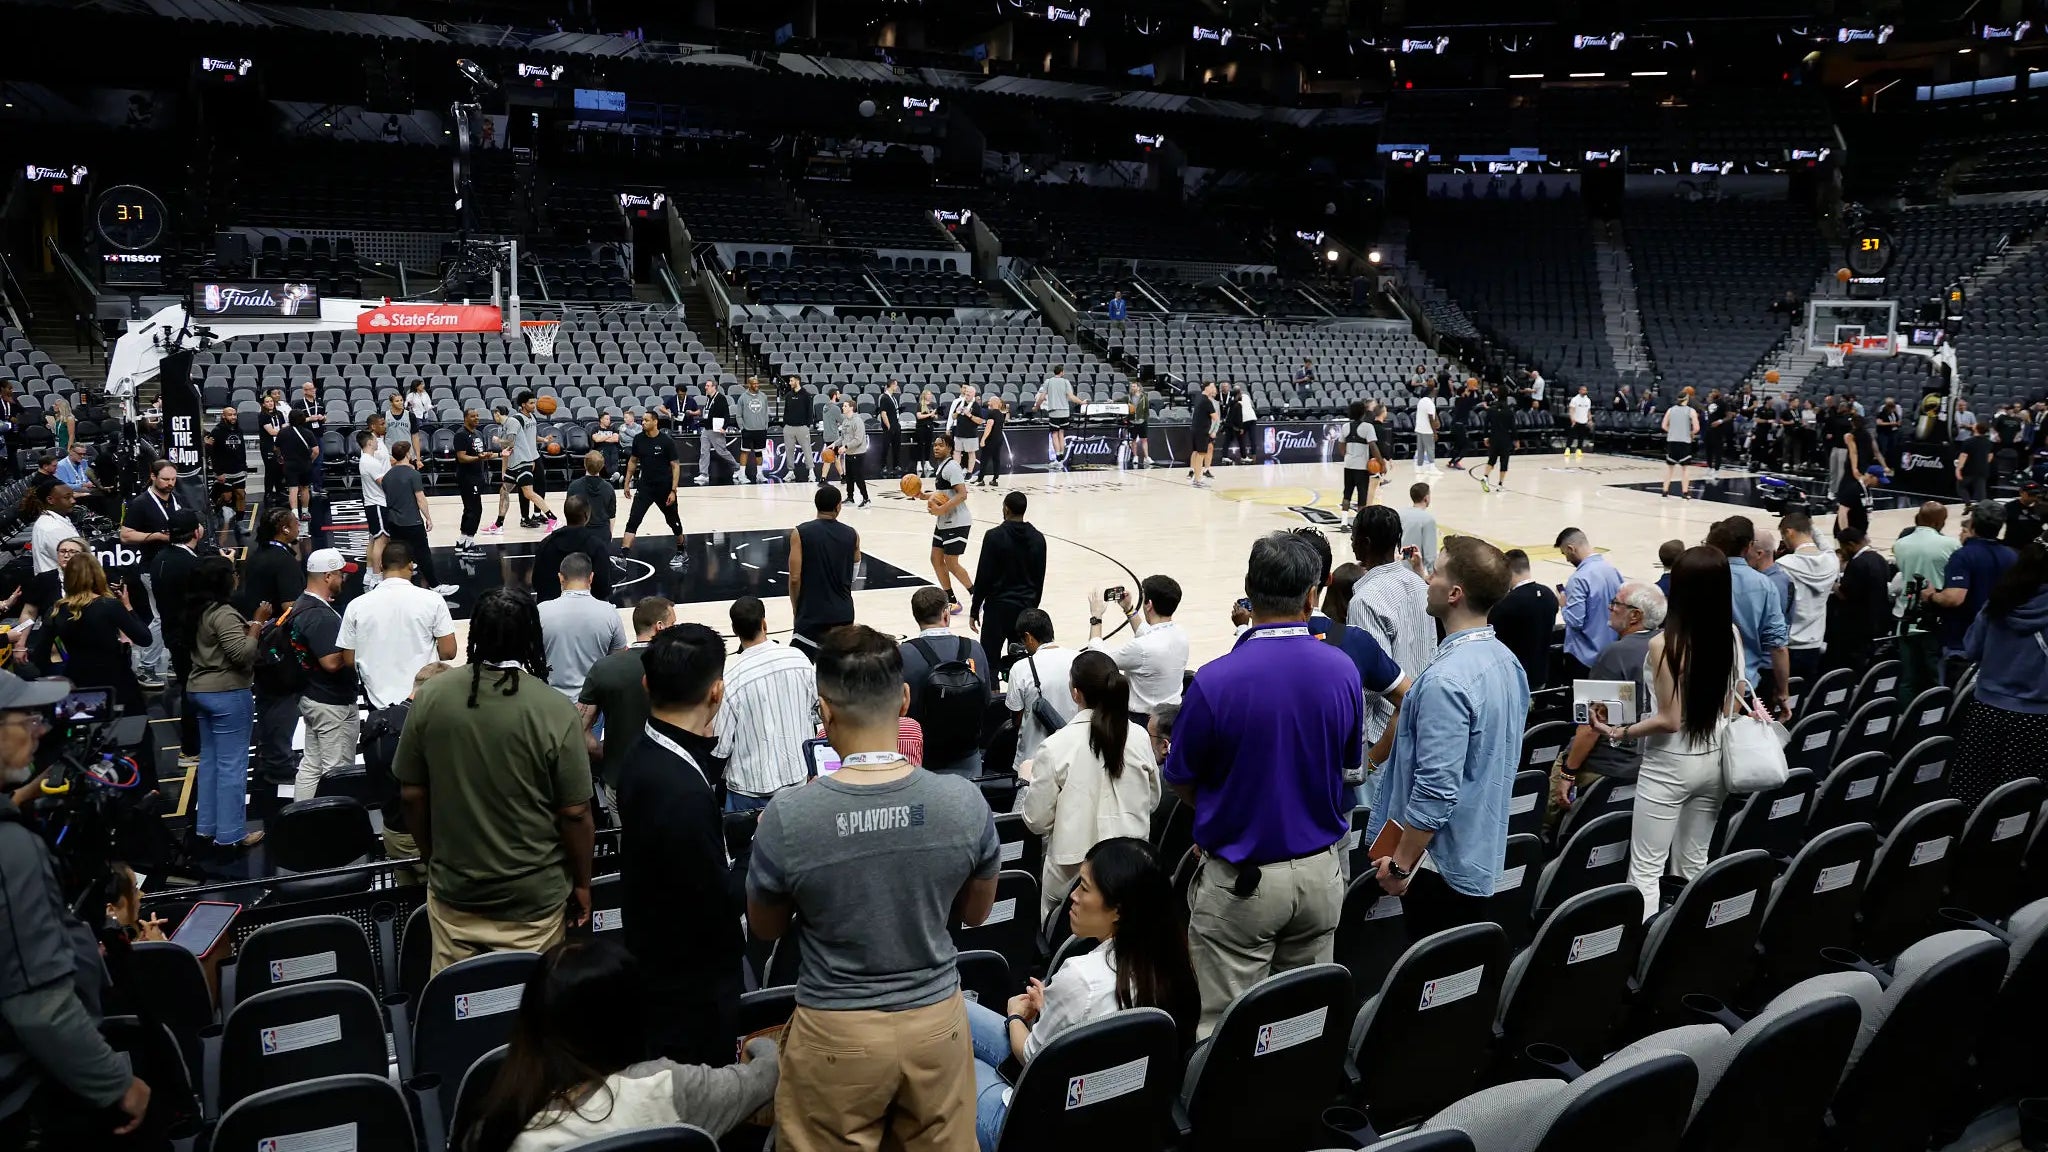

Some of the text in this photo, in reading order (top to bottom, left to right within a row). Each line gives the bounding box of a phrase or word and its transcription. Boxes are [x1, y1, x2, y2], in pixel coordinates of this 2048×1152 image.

[433, 24, 448, 33] 106
[208, 59, 237, 71] Finals
[523, 65, 549, 78] Finals
[33, 167, 69, 181] Finals
[118, 204, 143, 220] 3.7
[214, 288, 276, 313] Finals
[890, 311, 897, 321] 8
[172, 416, 192, 431] GET
[172, 432, 194, 446] THE
[1271, 430, 1317, 456] Finals
[1063, 435, 1111, 461] Finals
[179, 448, 199, 465] App
[1905, 454, 1944, 471] Finals
[330, 499, 368, 524] ULTRA
[850, 805, 910, 834] PLAYOFFS
